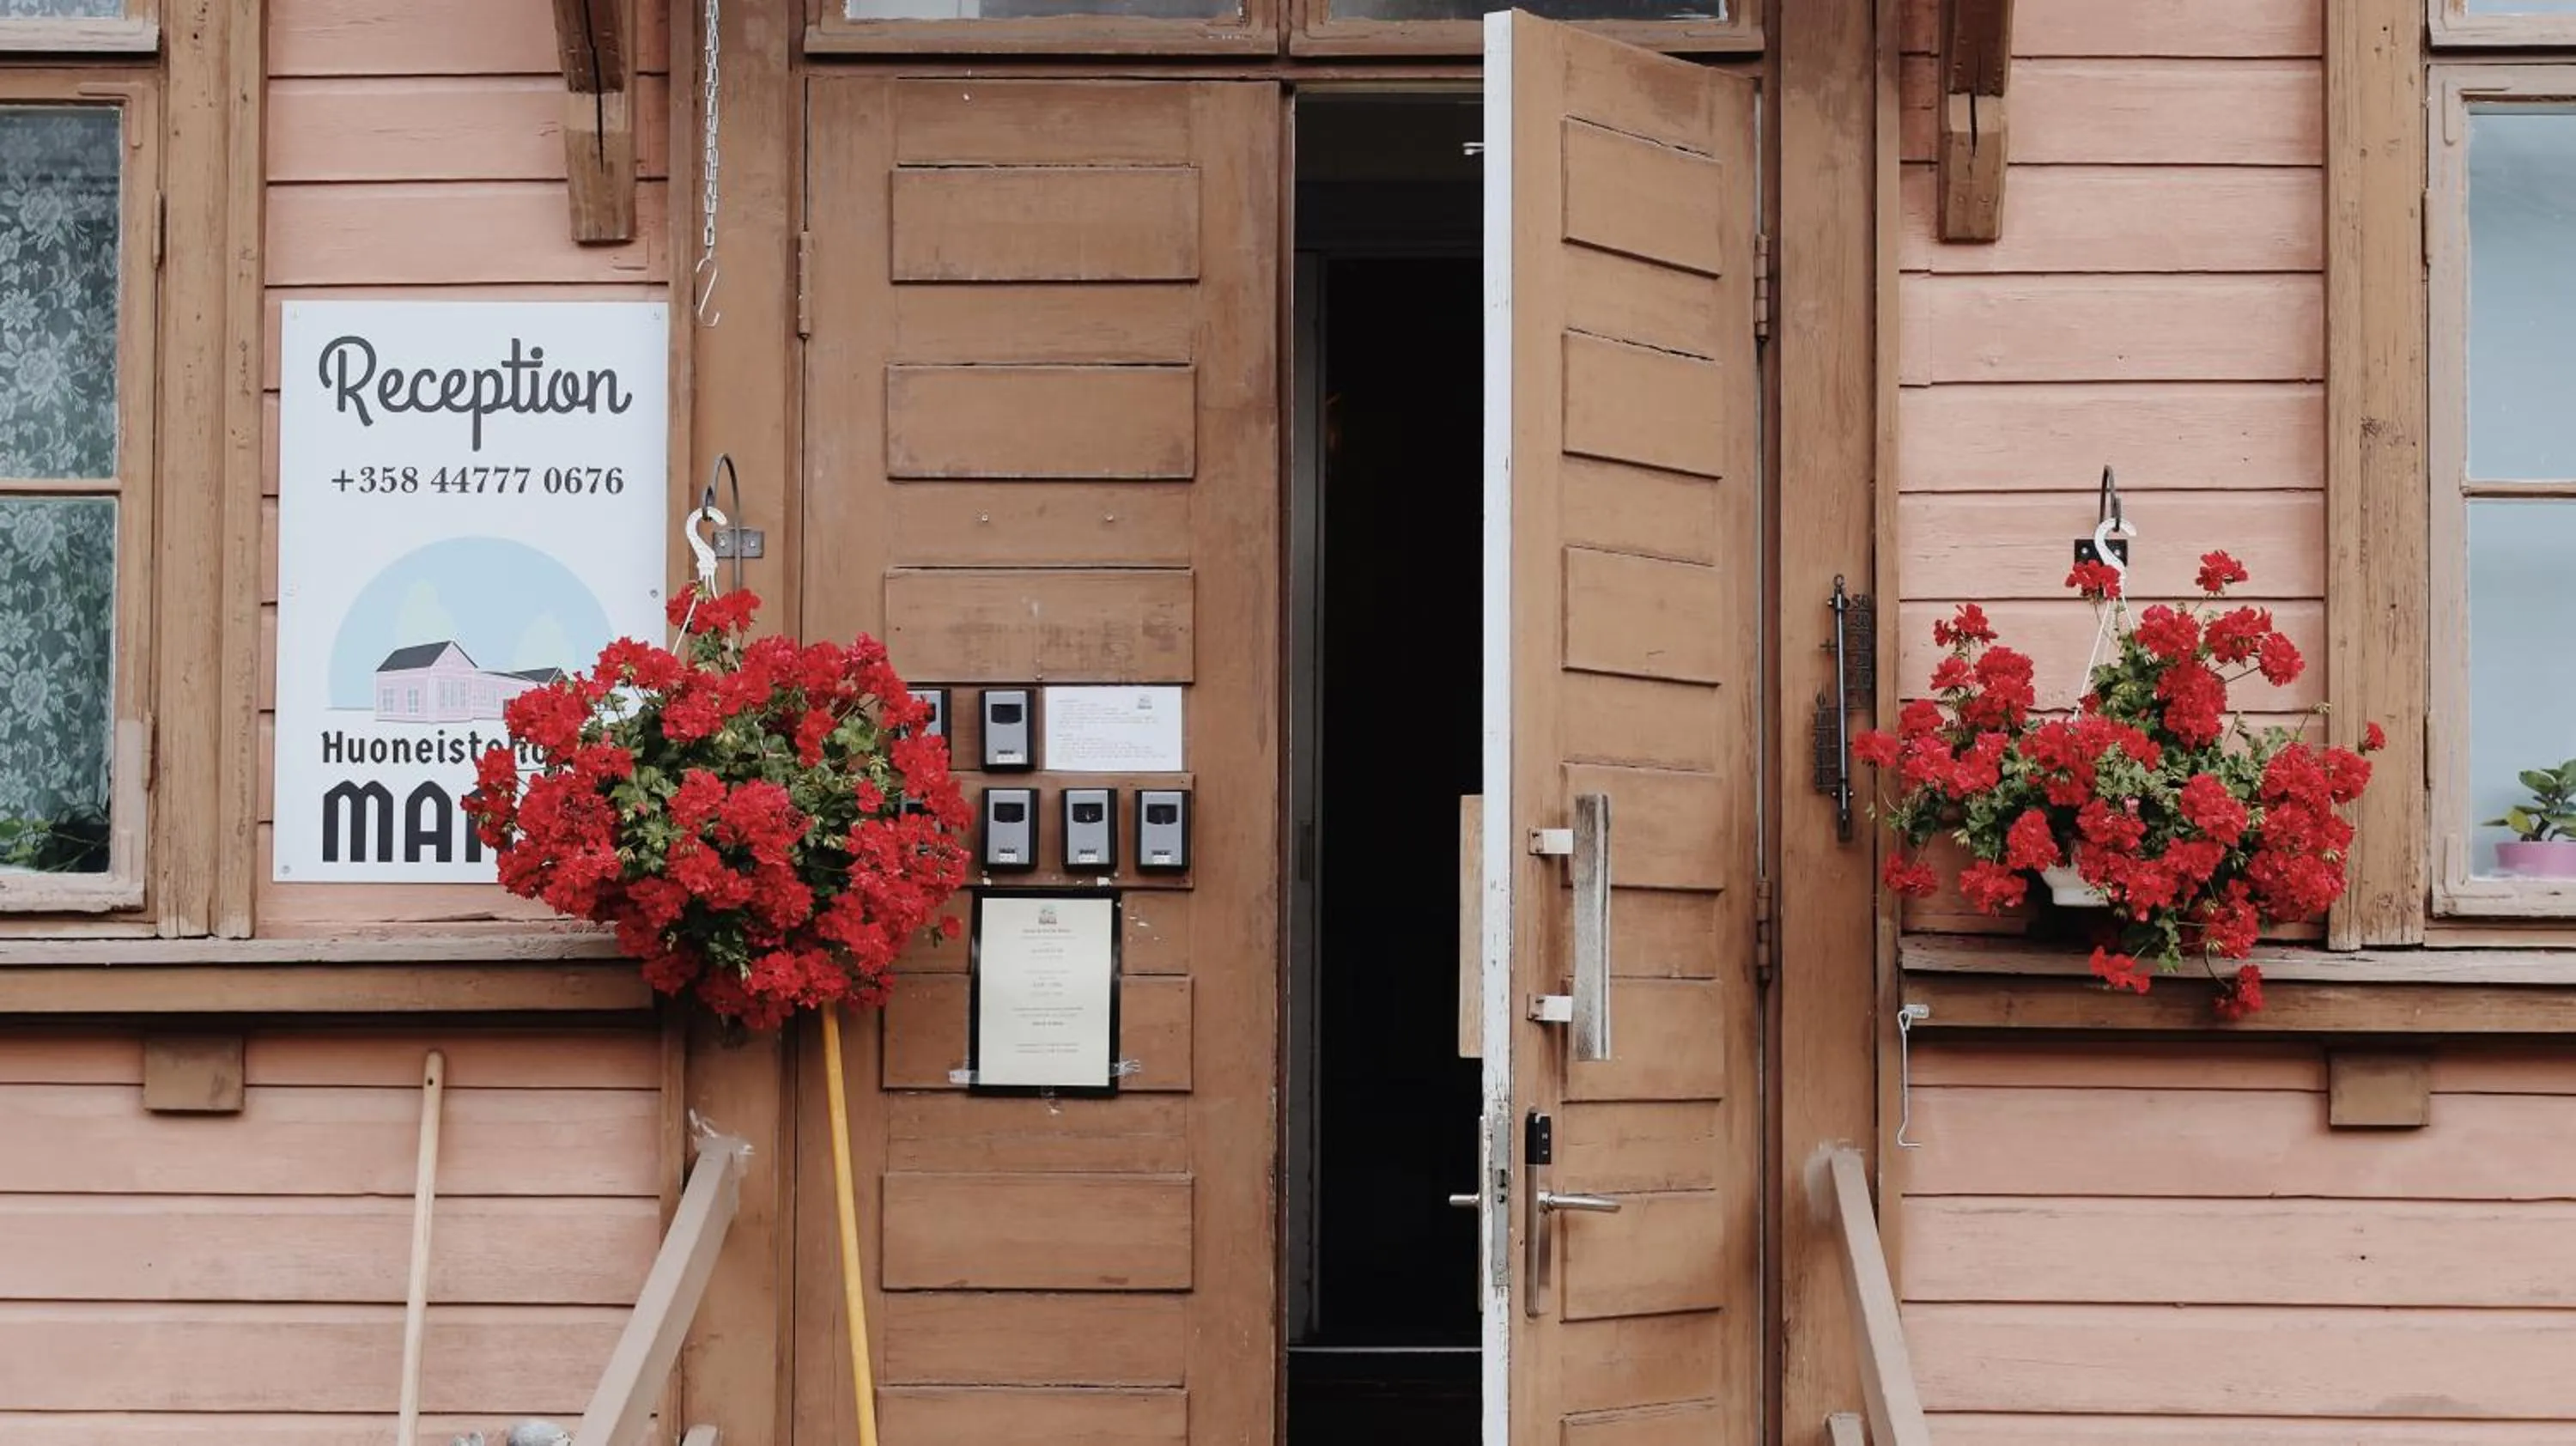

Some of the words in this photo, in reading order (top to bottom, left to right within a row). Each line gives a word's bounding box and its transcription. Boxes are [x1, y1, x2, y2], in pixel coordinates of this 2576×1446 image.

[319, 335, 633, 452] Reception
[331, 466, 418, 494] +358
[430, 466, 532, 494] 44777
[544, 466, 624, 495] 0676
